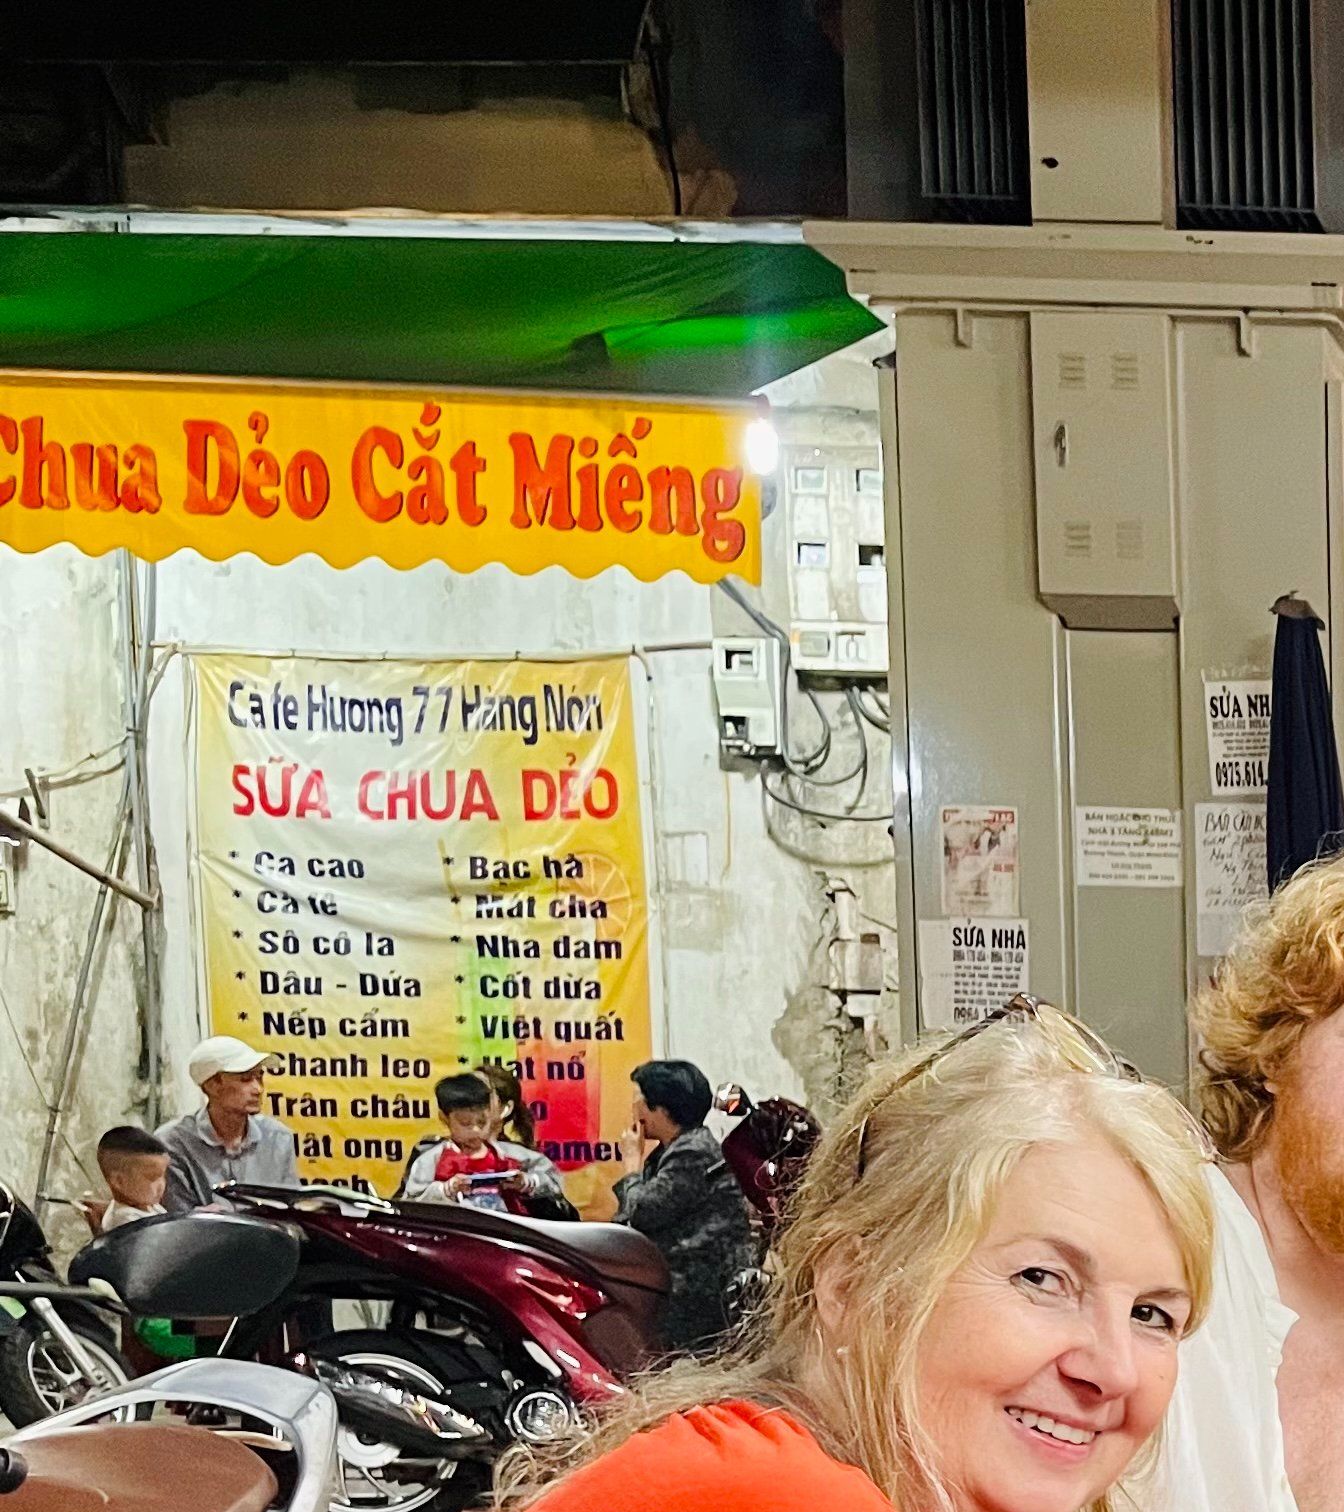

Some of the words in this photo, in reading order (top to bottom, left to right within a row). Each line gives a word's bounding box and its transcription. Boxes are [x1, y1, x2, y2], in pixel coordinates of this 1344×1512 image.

[183, 410, 330, 520] Dẻo
[351, 402, 487, 527] Cắt
[509, 418, 747, 563] Miếng
[1246, 694, 1271, 718] NH
[232, 756, 332, 820] SỮA
[358, 767, 500, 822] CHUA
[521, 752, 620, 822] DẺO
[307, 858, 366, 879] cao
[549, 893, 608, 918] cha
[258, 929, 300, 955] Sô
[365, 931, 395, 956] la
[475, 934, 541, 959] Nha
[991, 924, 1026, 949] NHÀ
[260, 970, 323, 996] Dâu
[359, 970, 422, 997] Dứa
[479, 970, 532, 999] Cốt
[263, 1007, 327, 1039] Nếp
[480, 1015, 544, 1045] Việt
[554, 1010, 625, 1043] quất
[267, 1052, 368, 1078] Chanh
[381, 1054, 431, 1079] leo
[267, 1092, 338, 1118] Trân
[350, 1094, 431, 1119] châu
[294, 1133, 333, 1163] ật
[344, 1138, 403, 1162] ong
